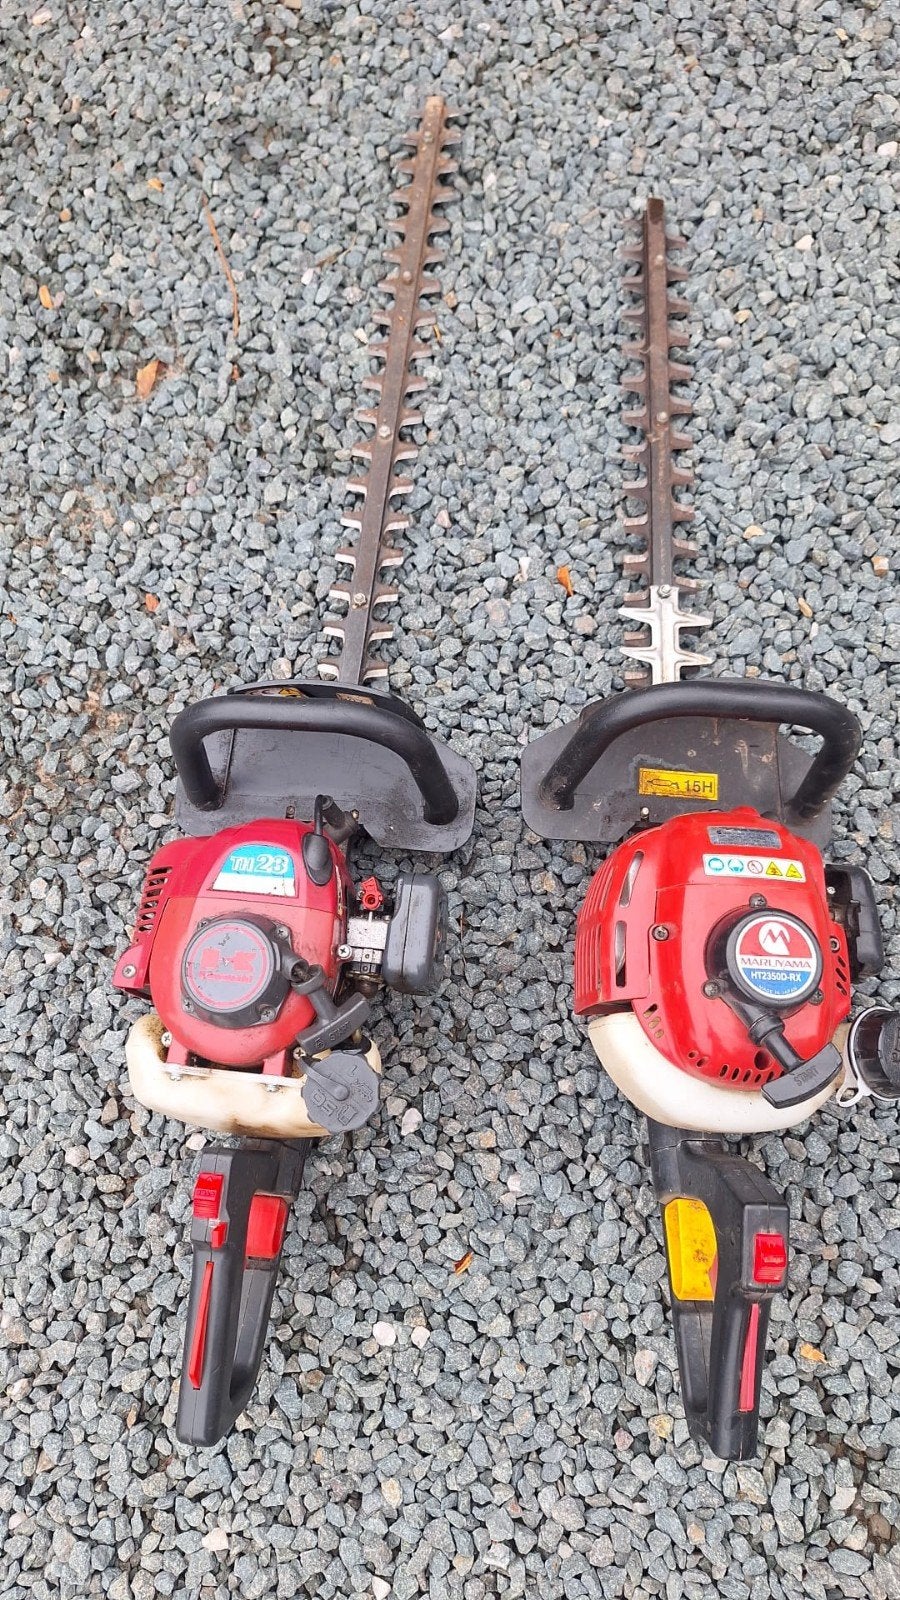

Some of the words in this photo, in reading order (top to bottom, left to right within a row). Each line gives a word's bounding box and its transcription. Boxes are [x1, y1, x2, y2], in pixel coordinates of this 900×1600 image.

[685, 779, 713, 793] 15H
[741, 958, 812, 969] MARUYAMA
[751, 971, 802, 982] HT2350D-RX
[793, 1065, 819, 1087] START
